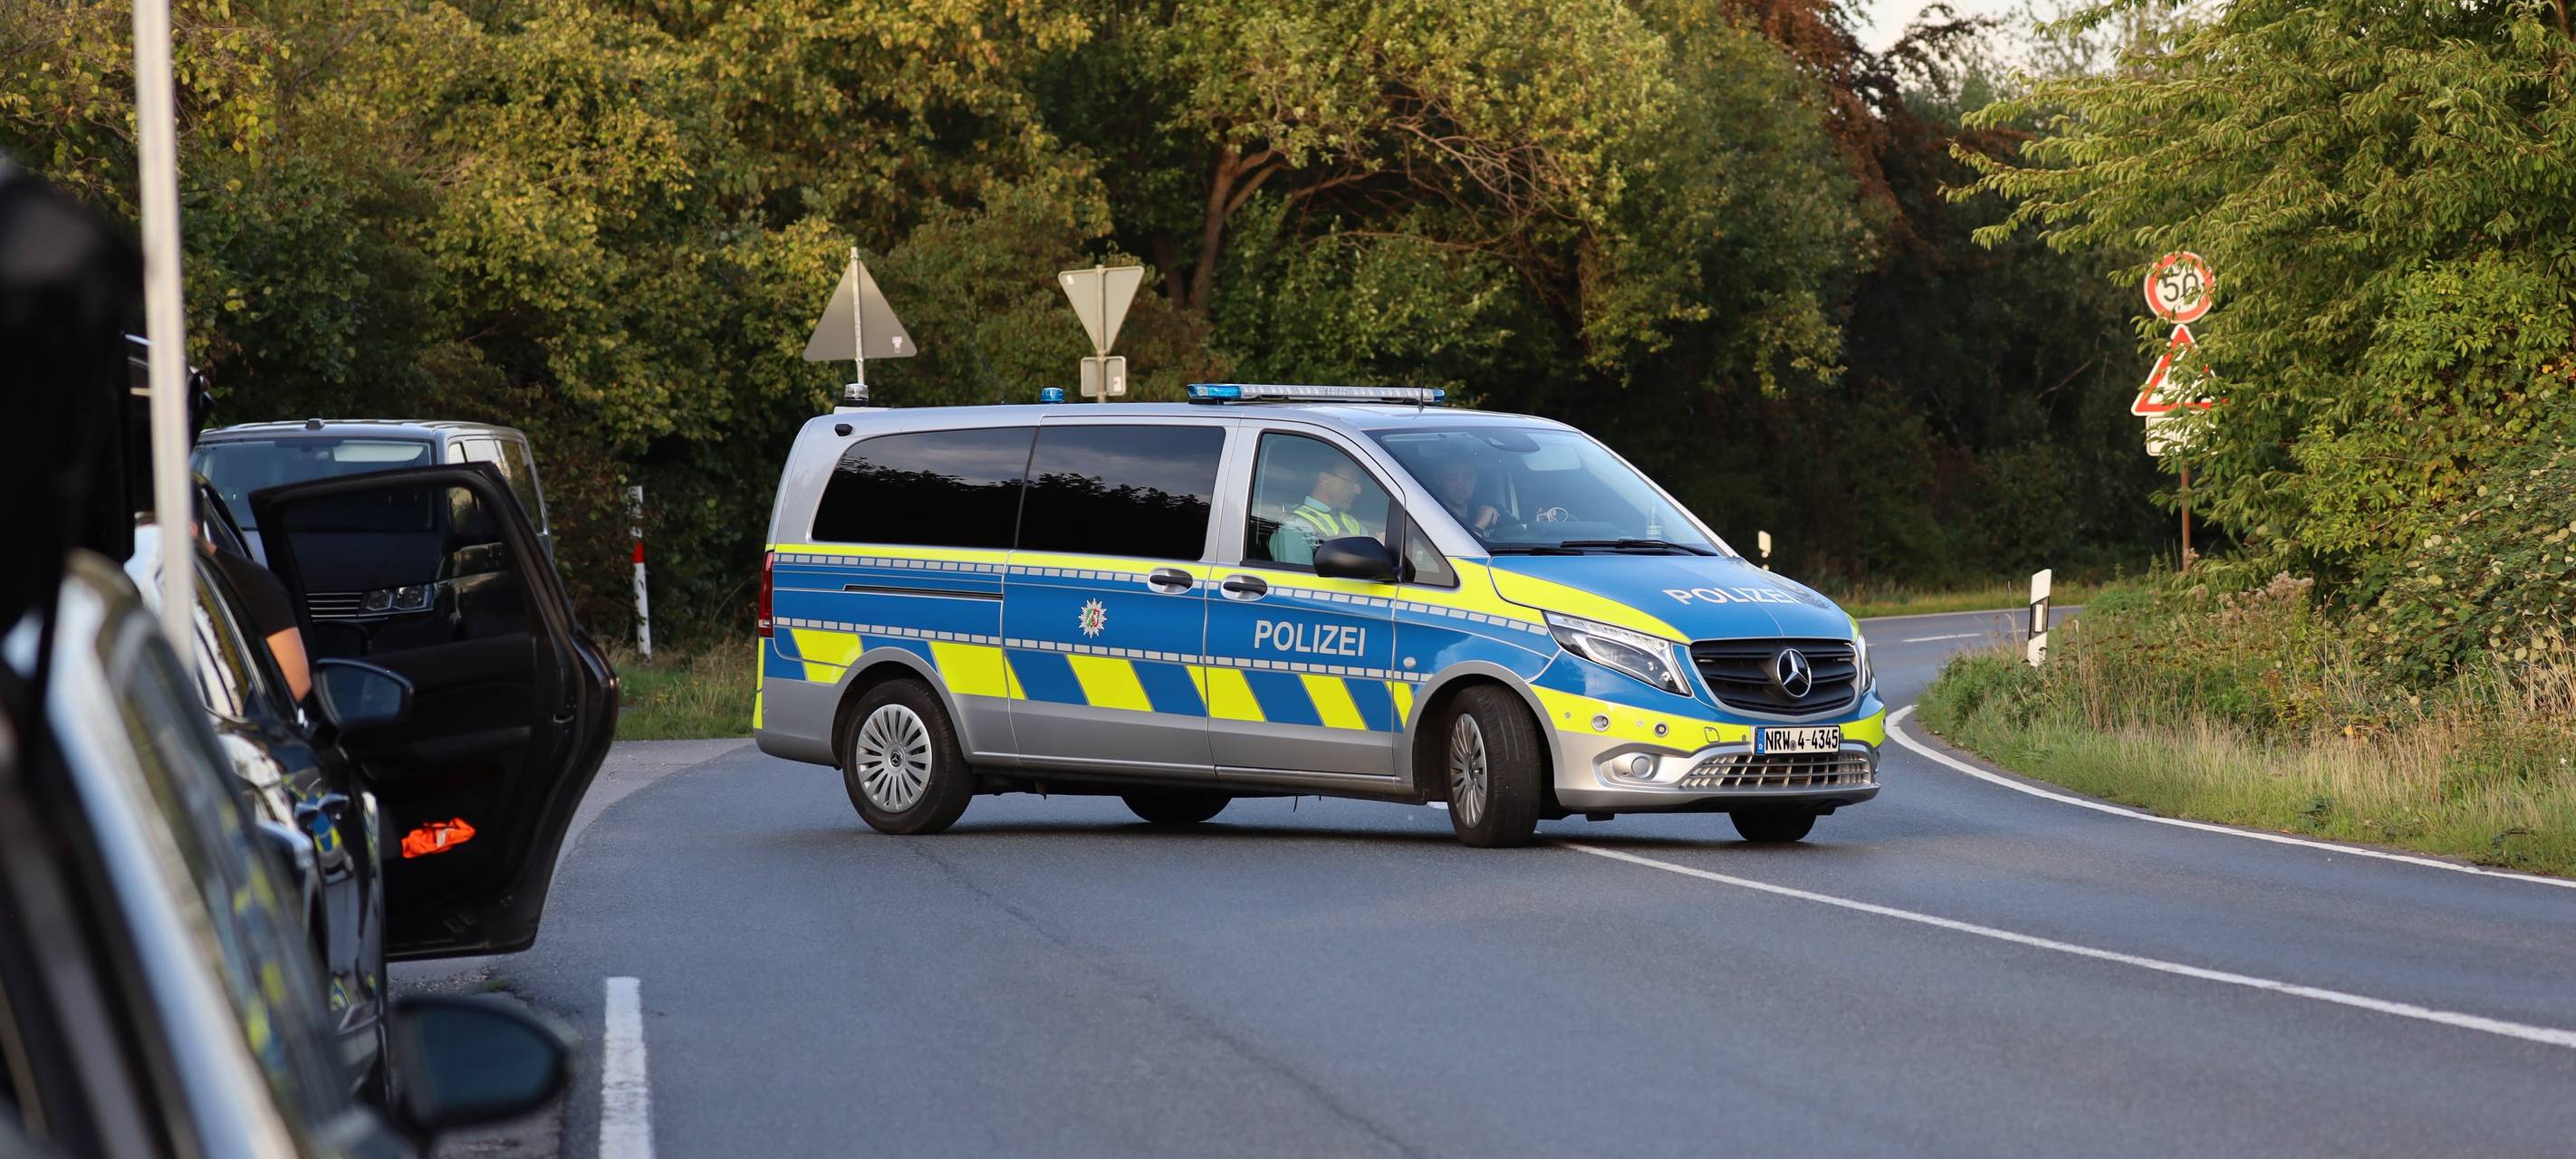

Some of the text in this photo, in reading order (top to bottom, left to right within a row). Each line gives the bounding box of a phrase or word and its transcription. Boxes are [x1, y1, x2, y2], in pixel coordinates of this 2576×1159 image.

[2163, 273, 2199, 302] 50
[1662, 588, 1802, 605] POLIZEI
[1254, 619, 1366, 656] POLIZEI
[1765, 729, 1839, 751] NRW 4-4345
